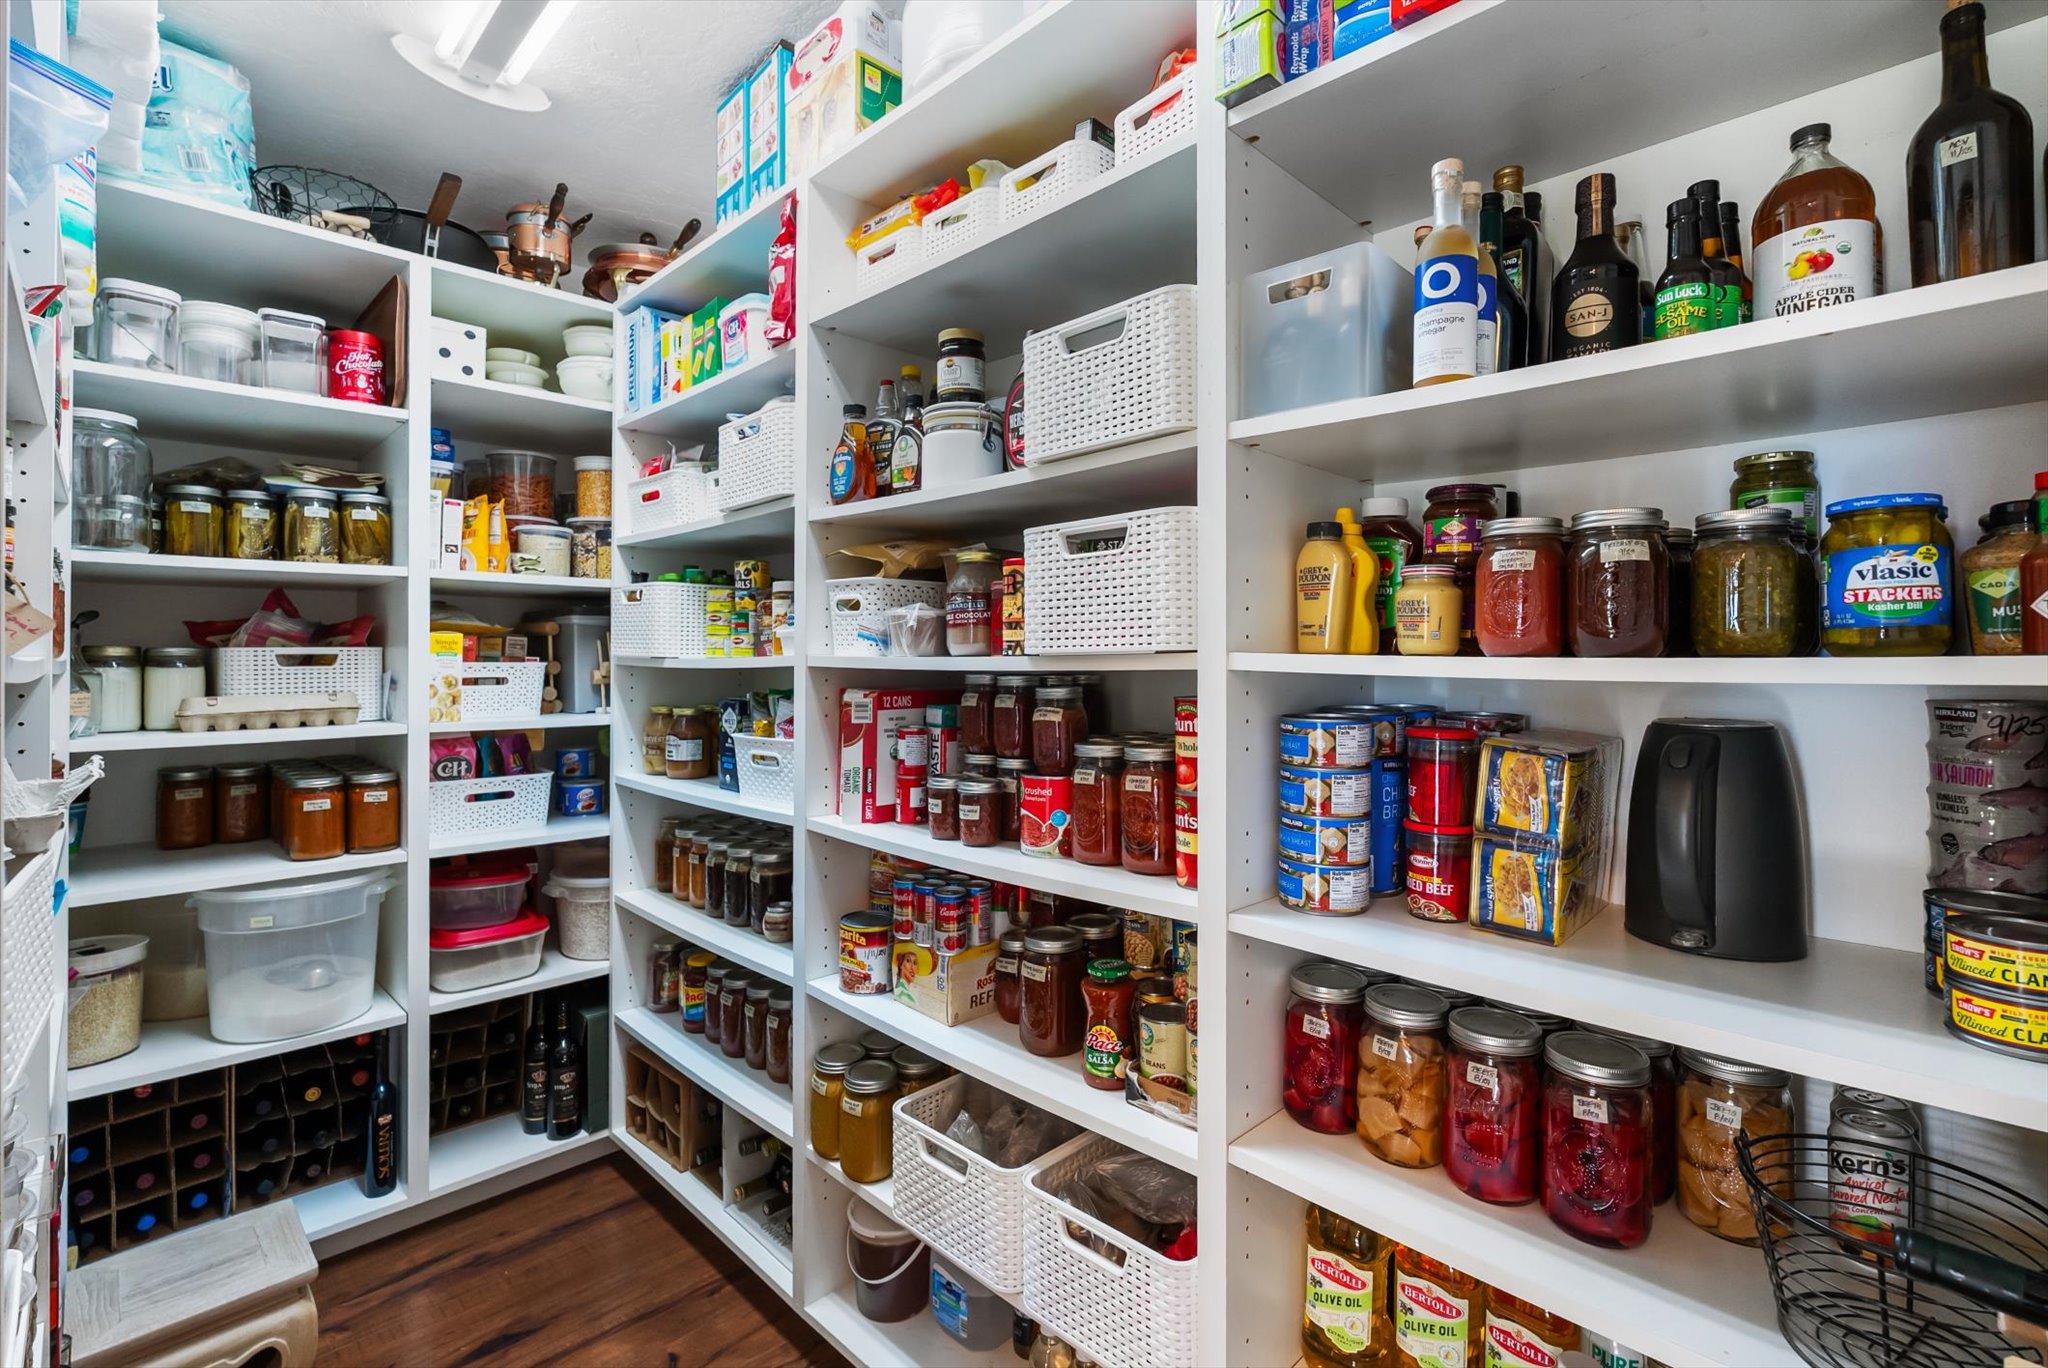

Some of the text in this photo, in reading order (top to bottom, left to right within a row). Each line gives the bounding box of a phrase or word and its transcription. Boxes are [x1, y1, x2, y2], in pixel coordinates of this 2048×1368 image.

[1290, 32, 1301, 74] Reynolds
[1299, 47, 1310, 74] Wrap
[1421, 262, 1461, 299] O
[1657, 284, 1703, 304] Sun Luck
[1775, 291, 1814, 308] APPLE
[1816, 286, 1855, 297] CIDER
[1418, 315, 1466, 331] champagne
[1569, 307, 1608, 323] SAN-J
[1655, 305, 1708, 328] SESAME
[1667, 317, 1690, 328] OIL
[1566, 341, 1612, 356] ORGANIC
[628, 323, 636, 402] PREMIUM
[1298, 574, 1332, 583] POUPON
[1303, 566, 1323, 574] GREY
[1855, 561, 1933, 582] vlasic
[1843, 585, 1943, 605] STACKERS
[1979, 581, 2016, 589] CADIA
[1396, 606, 1430, 615] POUPON
[1867, 601, 1924, 613] Kosher Dill
[883, 695, 913, 708] 12 CANS
[1936, 709, 1977, 718] KIRKLAND
[843, 769, 852, 793] TOMATO
[852, 766, 861, 795] ORGANIC
[1945, 763, 1995, 788] SALMON
[1024, 787, 1053, 797] crushed
[1426, 884, 1454, 895] BEEF
[1485, 875, 1495, 900] SPAM
[1951, 955, 1997, 979] Minced
[1956, 1012, 2008, 1038] Minced
[1086, 1032, 1122, 1052] Pace
[1088, 1053, 1115, 1065] SALSA
[1145, 1058, 1167, 1070] BEANS
[1829, 1151, 1907, 1176] Kern's
[1842, 1176, 1889, 1192] Apricot
[1313, 1260, 1364, 1290] BERTOLLI
[1313, 1291, 1362, 1308] OLIVE OIL
[1404, 1285, 1458, 1319] BERTOLLI
[1404, 1319, 1458, 1337] OLIVE OIL
[1491, 1327, 1550, 1367] BERTOLLI
[1591, 1343, 1640, 1368] PURE
